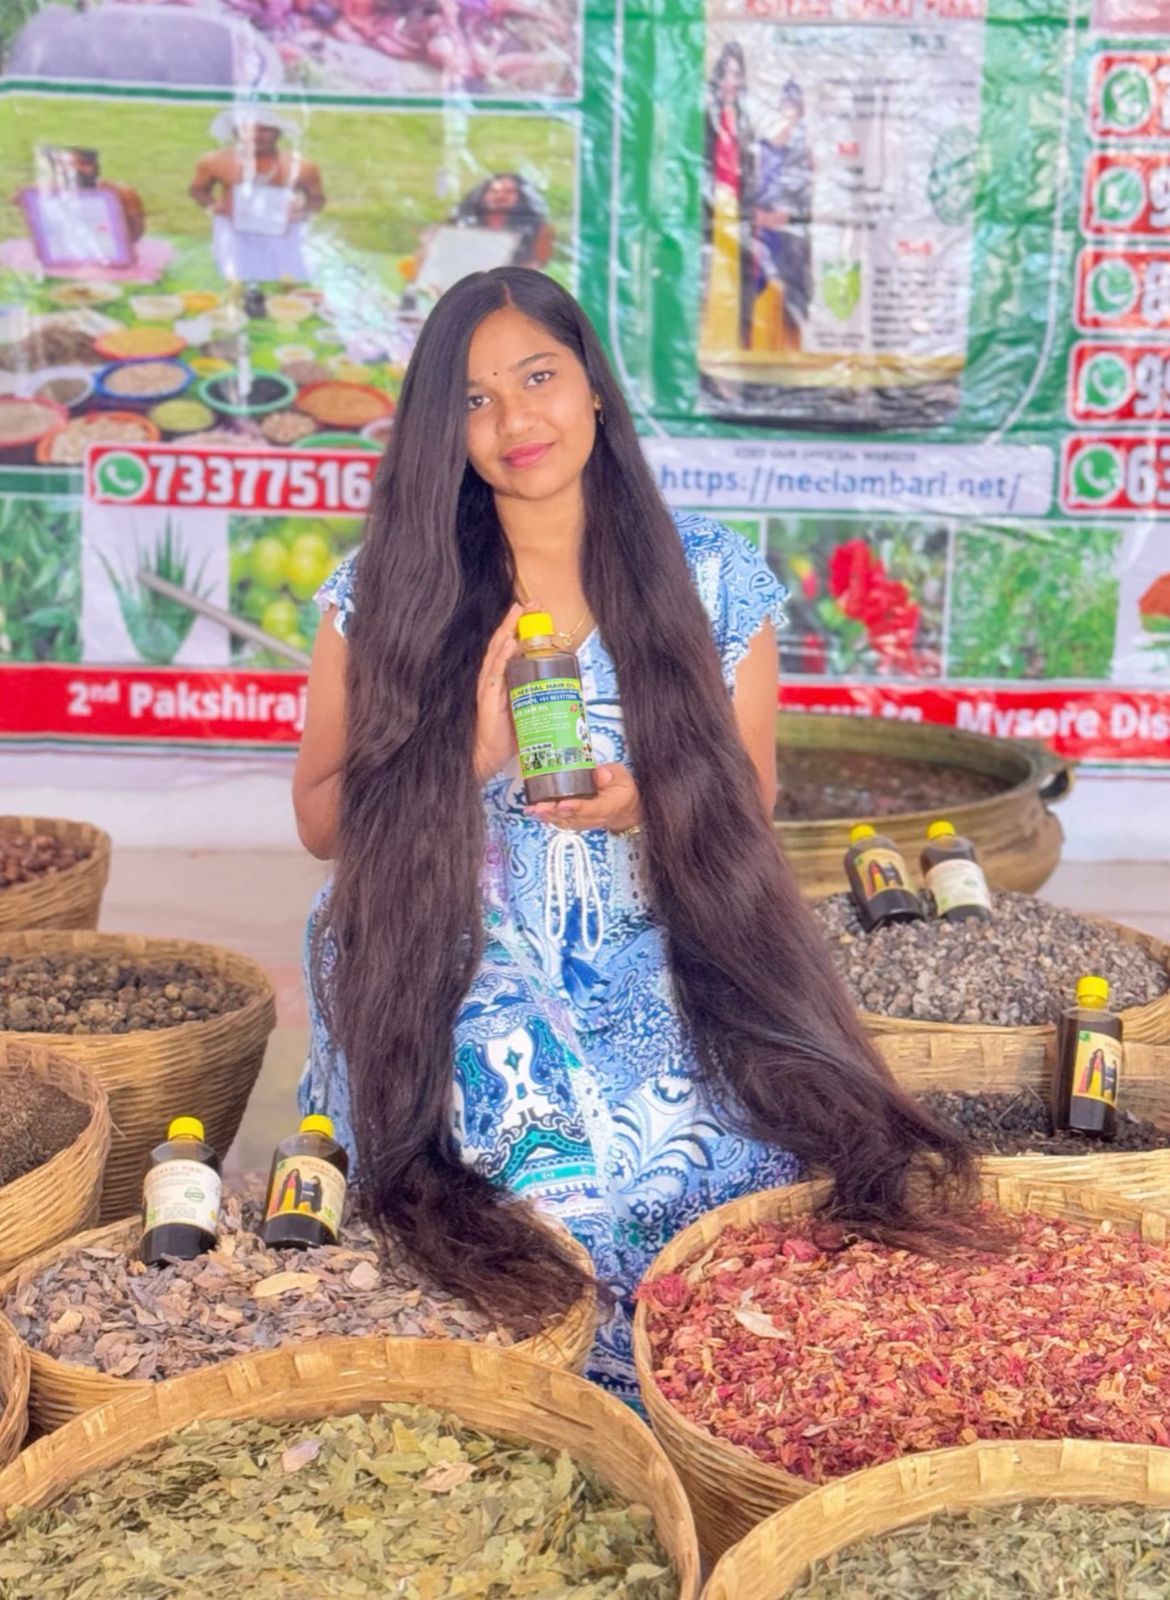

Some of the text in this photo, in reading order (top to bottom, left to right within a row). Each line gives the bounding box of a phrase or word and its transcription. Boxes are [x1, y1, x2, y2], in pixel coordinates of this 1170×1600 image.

[148, 455, 372, 508] 73377516
[67, 681, 308, 732] 2nd Pakshiraj
[956, 700, 1100, 739] Mysore
[1110, 702, 1170, 740] Dis
